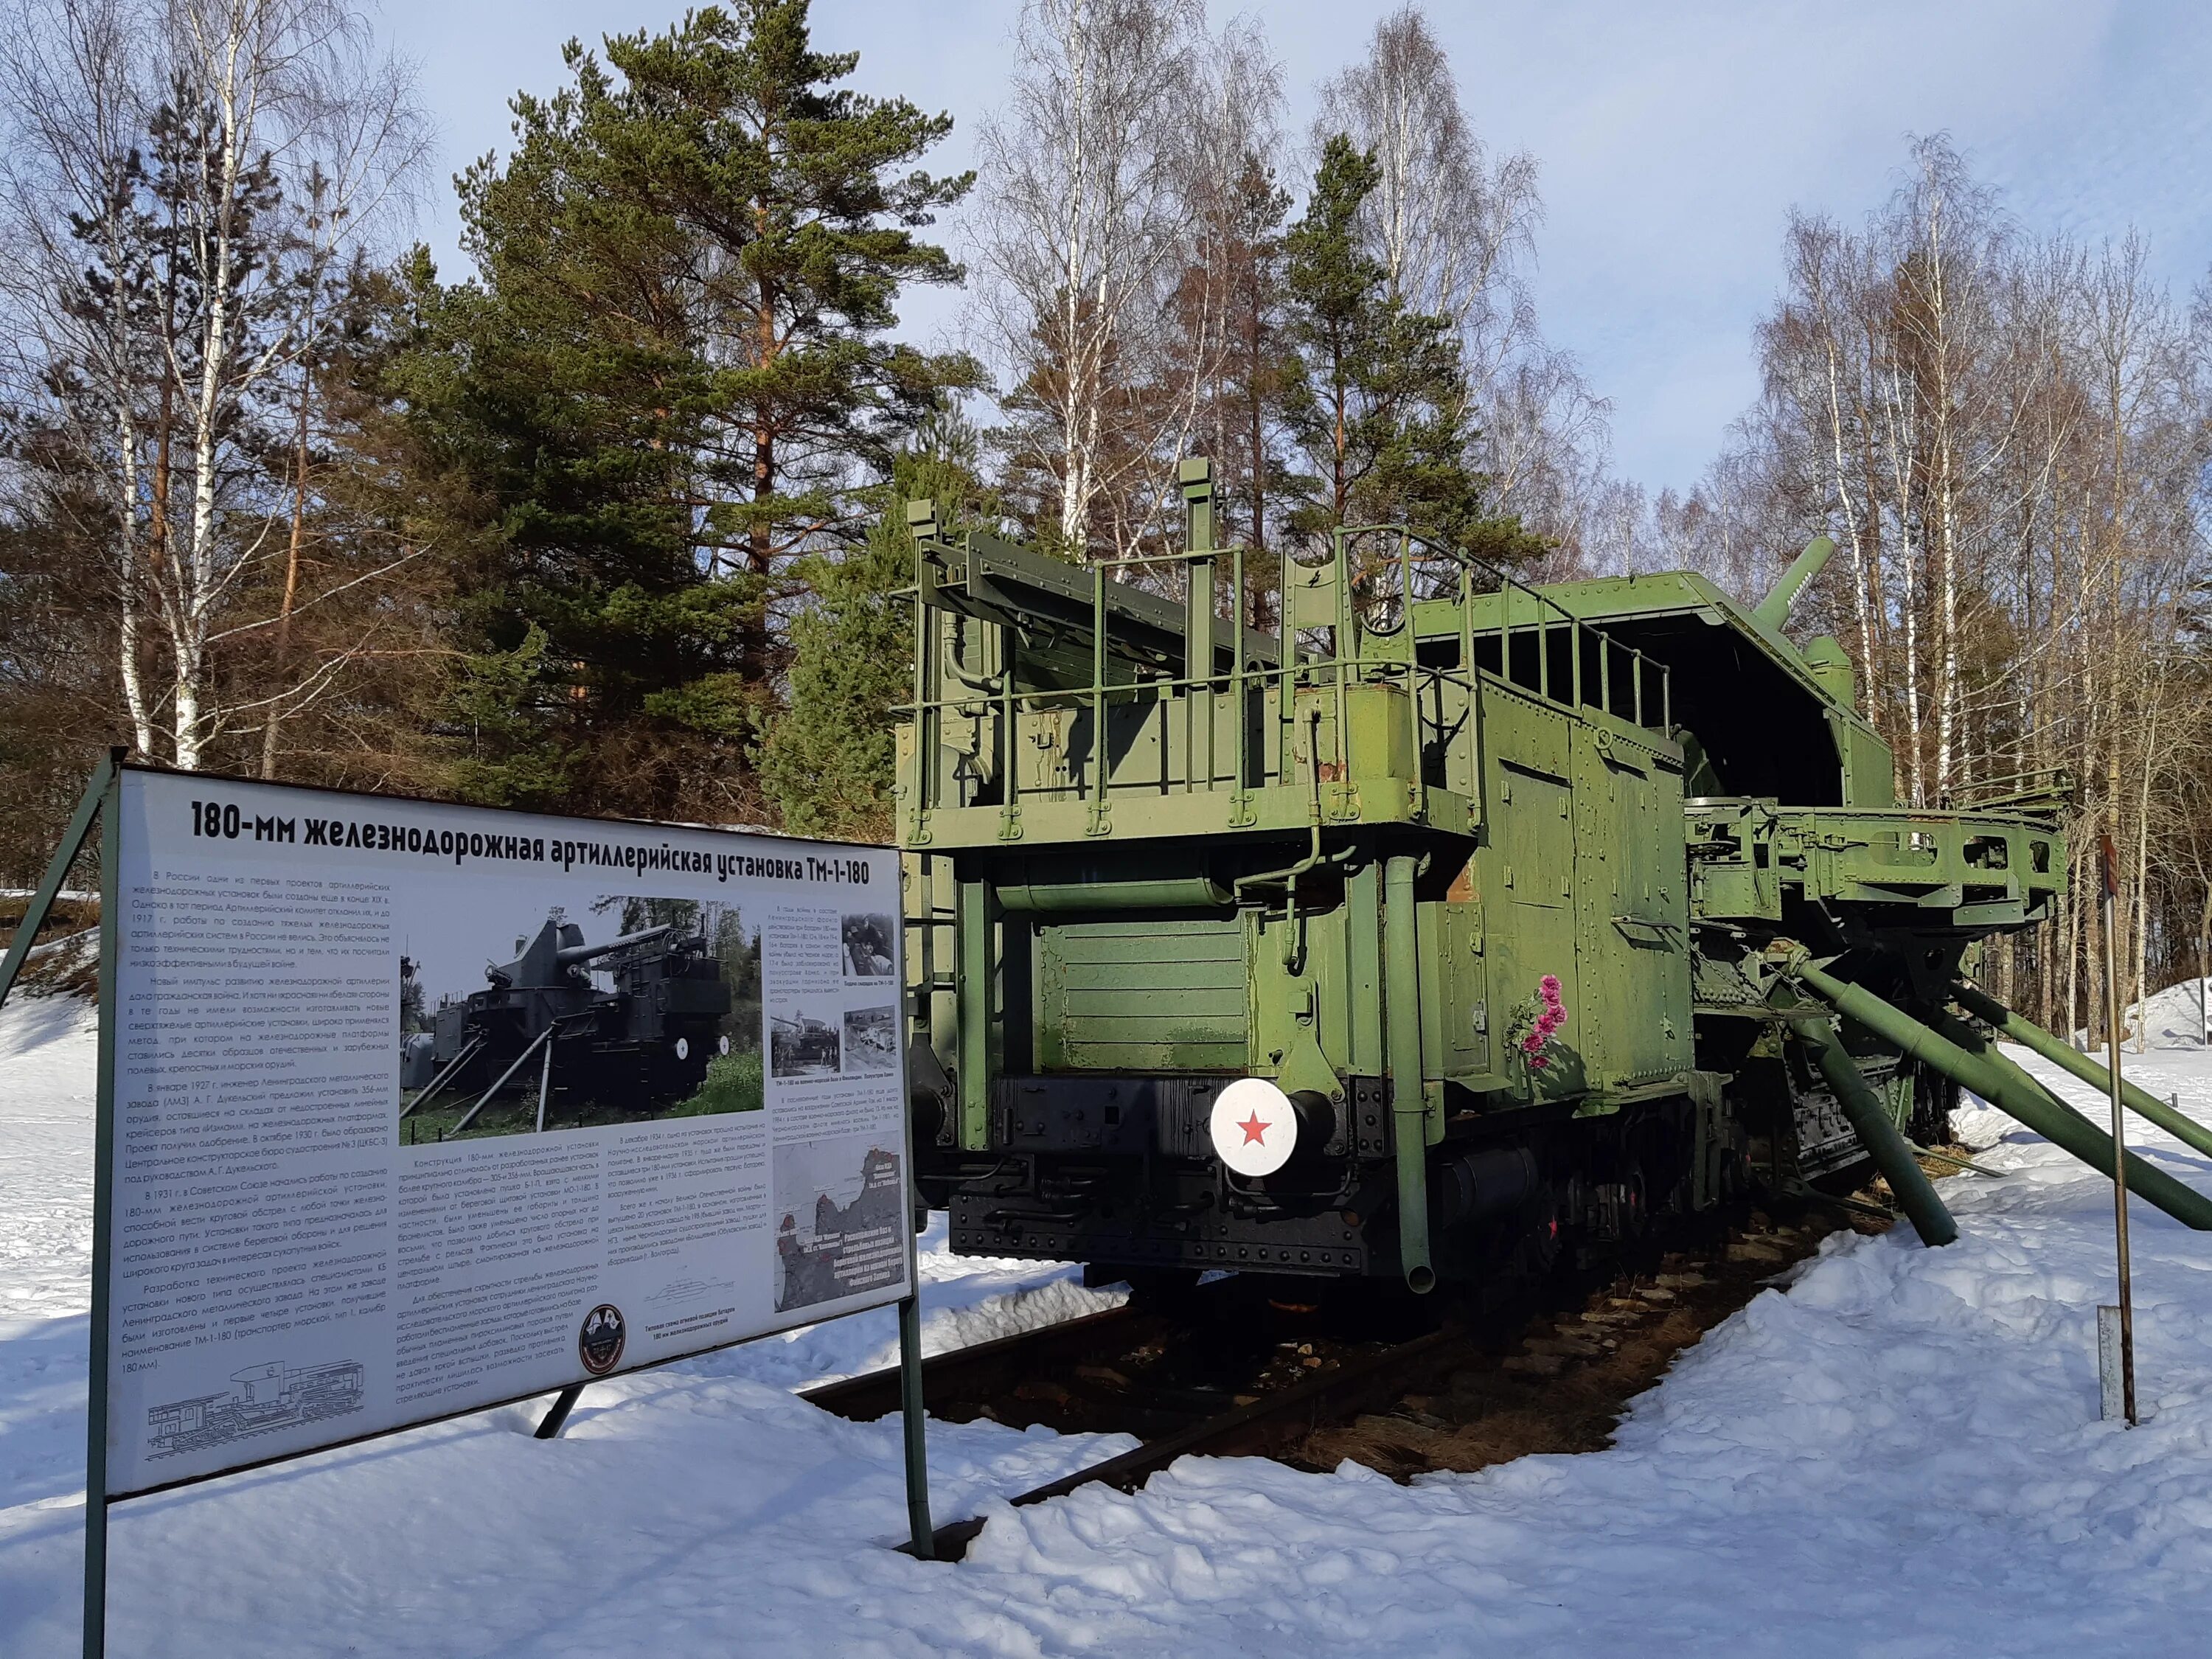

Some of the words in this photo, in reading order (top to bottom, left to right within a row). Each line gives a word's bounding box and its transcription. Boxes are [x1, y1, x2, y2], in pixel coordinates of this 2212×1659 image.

[192, 801, 295, 843] 180-мм
[304, 819, 543, 865] железнодорожная
[551, 841, 712, 877] артиллерийская
[718, 855, 802, 882] установка
[807, 858, 869, 884] ТМ-1-180
[153, 871, 158, 879] В
[165, 872, 199, 881] России
[250, 878, 279, 886] первых
[286, 880, 322, 888] проектов
[329, 882, 390, 891] артиллерийских
[150, 977, 178, 985] Новый
[268, 977, 342, 986] железнодорожной
[128, 1051, 175, 1060] ставились
[181, 1050, 215, 1058] десятки
[223, 1047, 263, 1057] образцов
[269, 1046, 327, 1054] отечественных
[344, 1043, 389, 1052] зарубежных
[169, 1037, 186, 1046] при
[193, 1036, 233, 1044] котором
[258, 1033, 335, 1041] железнодорожные
[342, 1030, 389, 1039] платформы
[126, 1100, 159, 1108] завода
[163, 1096, 189, 1107] (ЛМЗ)
[217, 1091, 265, 1104] Дукельский
[269, 1091, 313, 1100] предложил
[318, 1088, 358, 1097] установить
[361, 1085, 388, 1093] 356-мм
[147, 1083, 153, 1092] В
[155, 1084, 187, 1092] январе
[191, 1080, 209, 1089] 1927
[262, 1077, 327, 1085] Ленинградского
[329, 1073, 389, 1082] металлического
[125, 1144, 158, 1155] Проект
[161, 1141, 195, 1151] получил
[252, 1134, 257, 1142] В
[260, 1132, 292, 1141] октябре
[296, 1130, 312, 1138] 1930
[321, 1128, 341, 1136] было
[344, 1125, 388, 1135] образовано
[123, 1218, 176, 1232] способной
[181, 1217, 205, 1225] вести
[209, 1209, 248, 1223] круговой
[251, 1207, 285, 1217] обстрел
[300, 1200, 326, 1211] любой
[330, 1199, 349, 1207] точки
[353, 1195, 386, 1204] железно-
[125, 1206, 161, 1217] 180-мм
[169, 1194, 259, 1211] железнодорожной
[265, 1185, 338, 1202] артиллерийской
[122, 1248, 191, 1263] использования
[203, 1241, 240, 1252] системе
[244, 1233, 288, 1247] береговой
[291, 1229, 327, 1240] обороны
[338, 1226, 350, 1234] для
[353, 1221, 386, 1233] решения
[143, 1279, 199, 1294] Разработка
[206, 1269, 265, 1284] технического
[272, 1263, 306, 1275] проекта
[313, 1249, 386, 1267] железнодорожной
[122, 1299, 169, 1315] установки
[175, 1293, 205, 1304] нового
[212, 1289, 232, 1298] типа
[237, 1277, 305, 1294] осуществлялась
[311, 1267, 372, 1282] специалистами
[378, 1262, 386, 1271] КБ
[122, 1309, 198, 1328] Ленинградского
[201, 1297, 271, 1315] металлического
[308, 1287, 319, 1296] На
[324, 1285, 342, 1294] этом
[361, 1278, 386, 1287] заводе
[121, 1333, 145, 1343] были
[151, 1322, 205, 1338] изготовлены
[223, 1314, 254, 1325] первые
[260, 1308, 288, 1318] четыре
[341, 1291, 386, 1304] получившие
[121, 1340, 191, 1359] наименование
[195, 1330, 232, 1345] ТМ-1-180
[358, 1304, 386, 1315] калибр
[122, 1362, 137, 1374] 180
